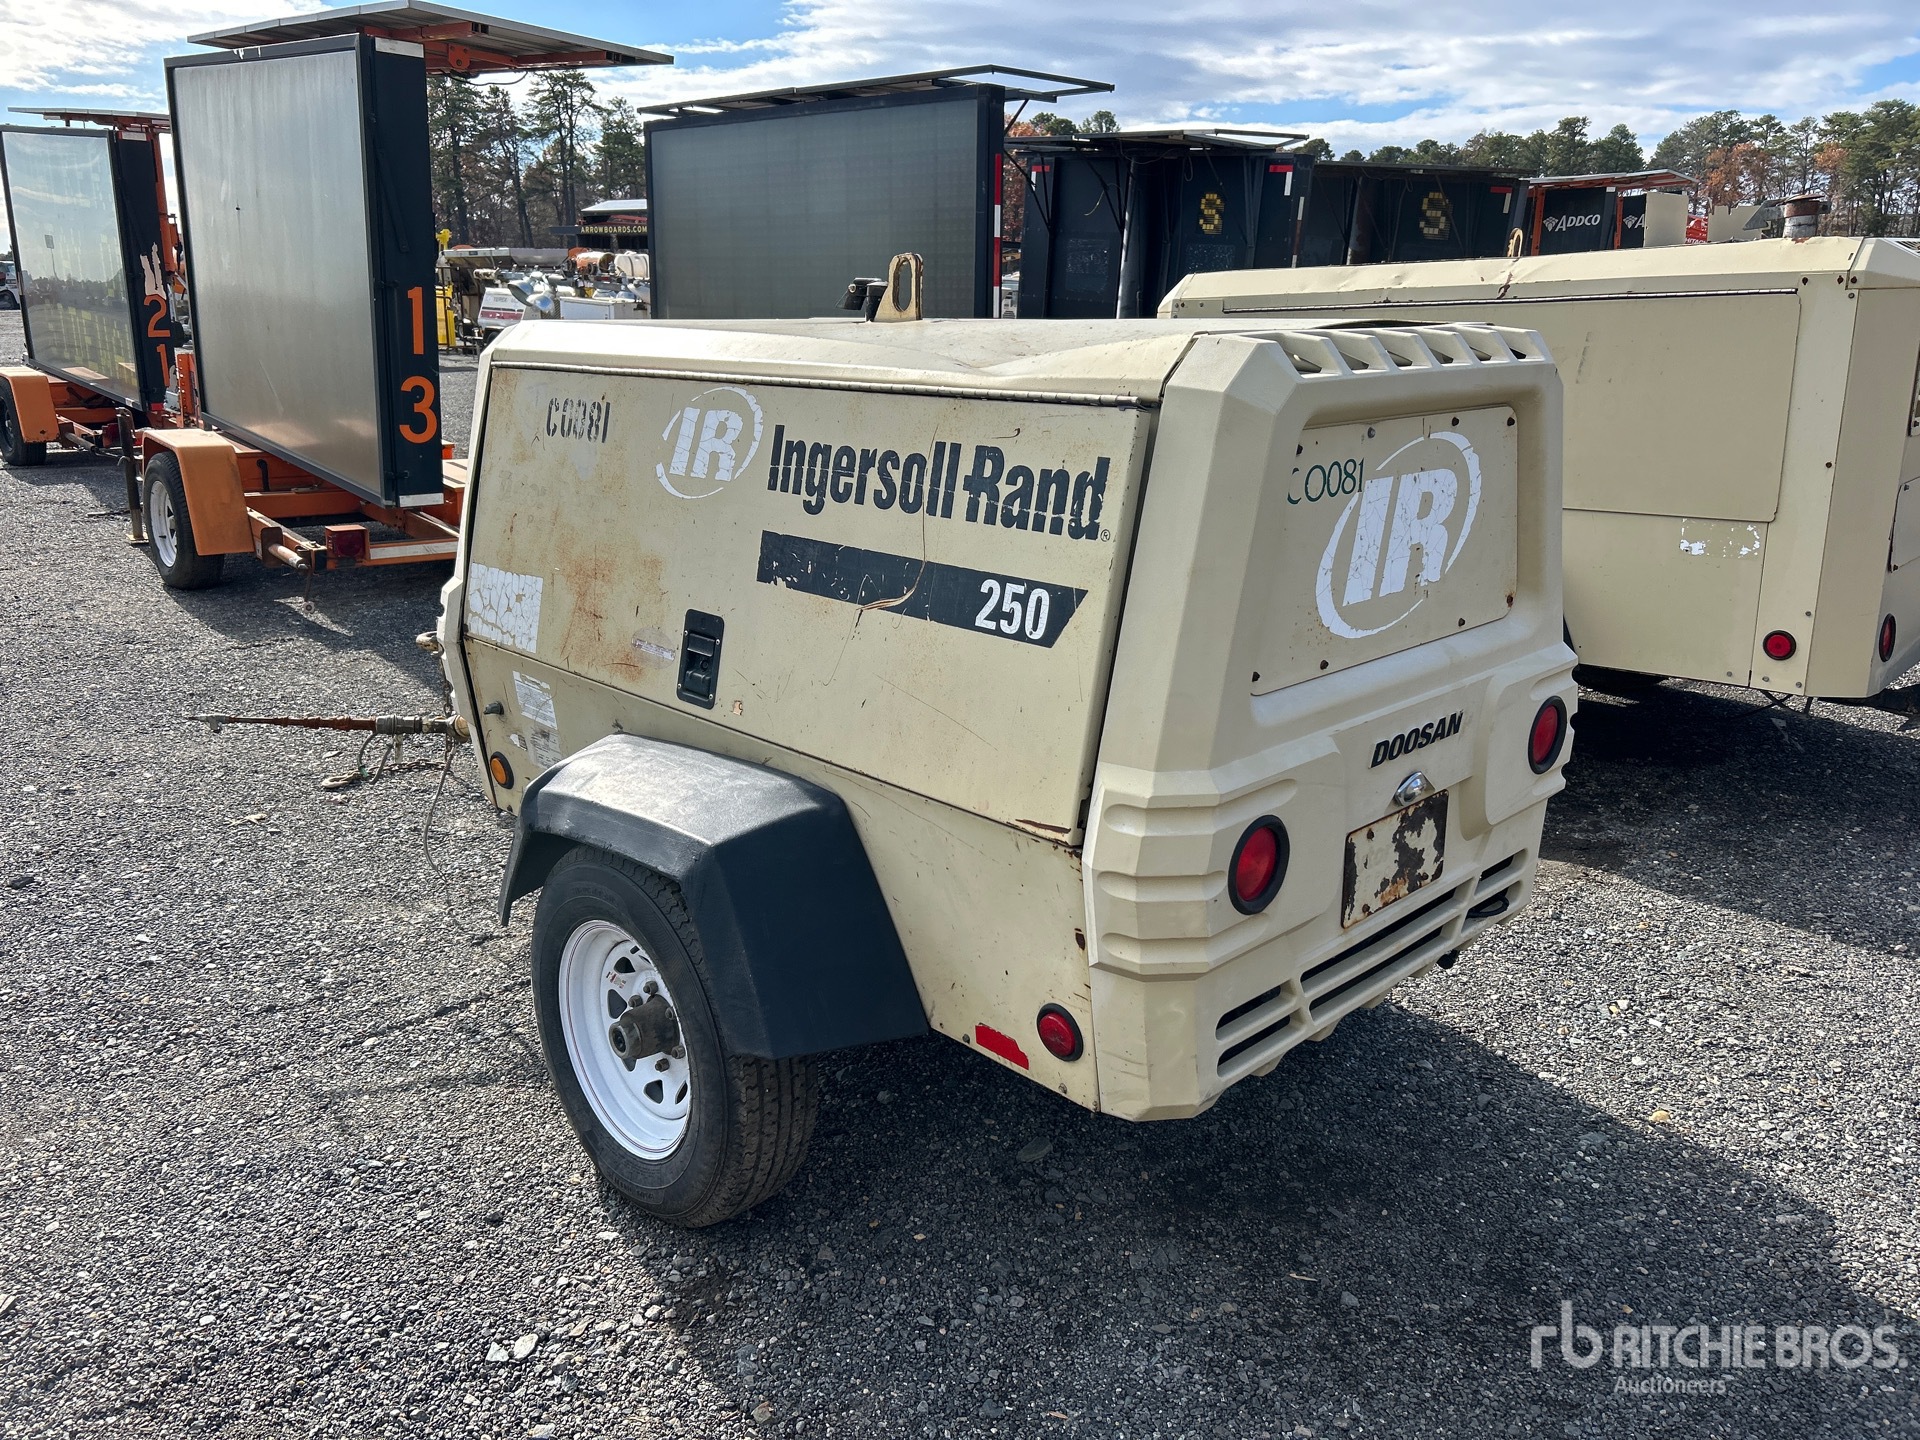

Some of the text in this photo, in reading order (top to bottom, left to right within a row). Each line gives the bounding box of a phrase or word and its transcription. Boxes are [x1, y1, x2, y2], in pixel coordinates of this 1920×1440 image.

[580, 225, 648, 234] ARROWBOARDS.COM
[1555, 214, 1600, 232] ADDCO
[974, 578, 1051, 641] 250
[1370, 710, 1464, 769] DOOSAN
